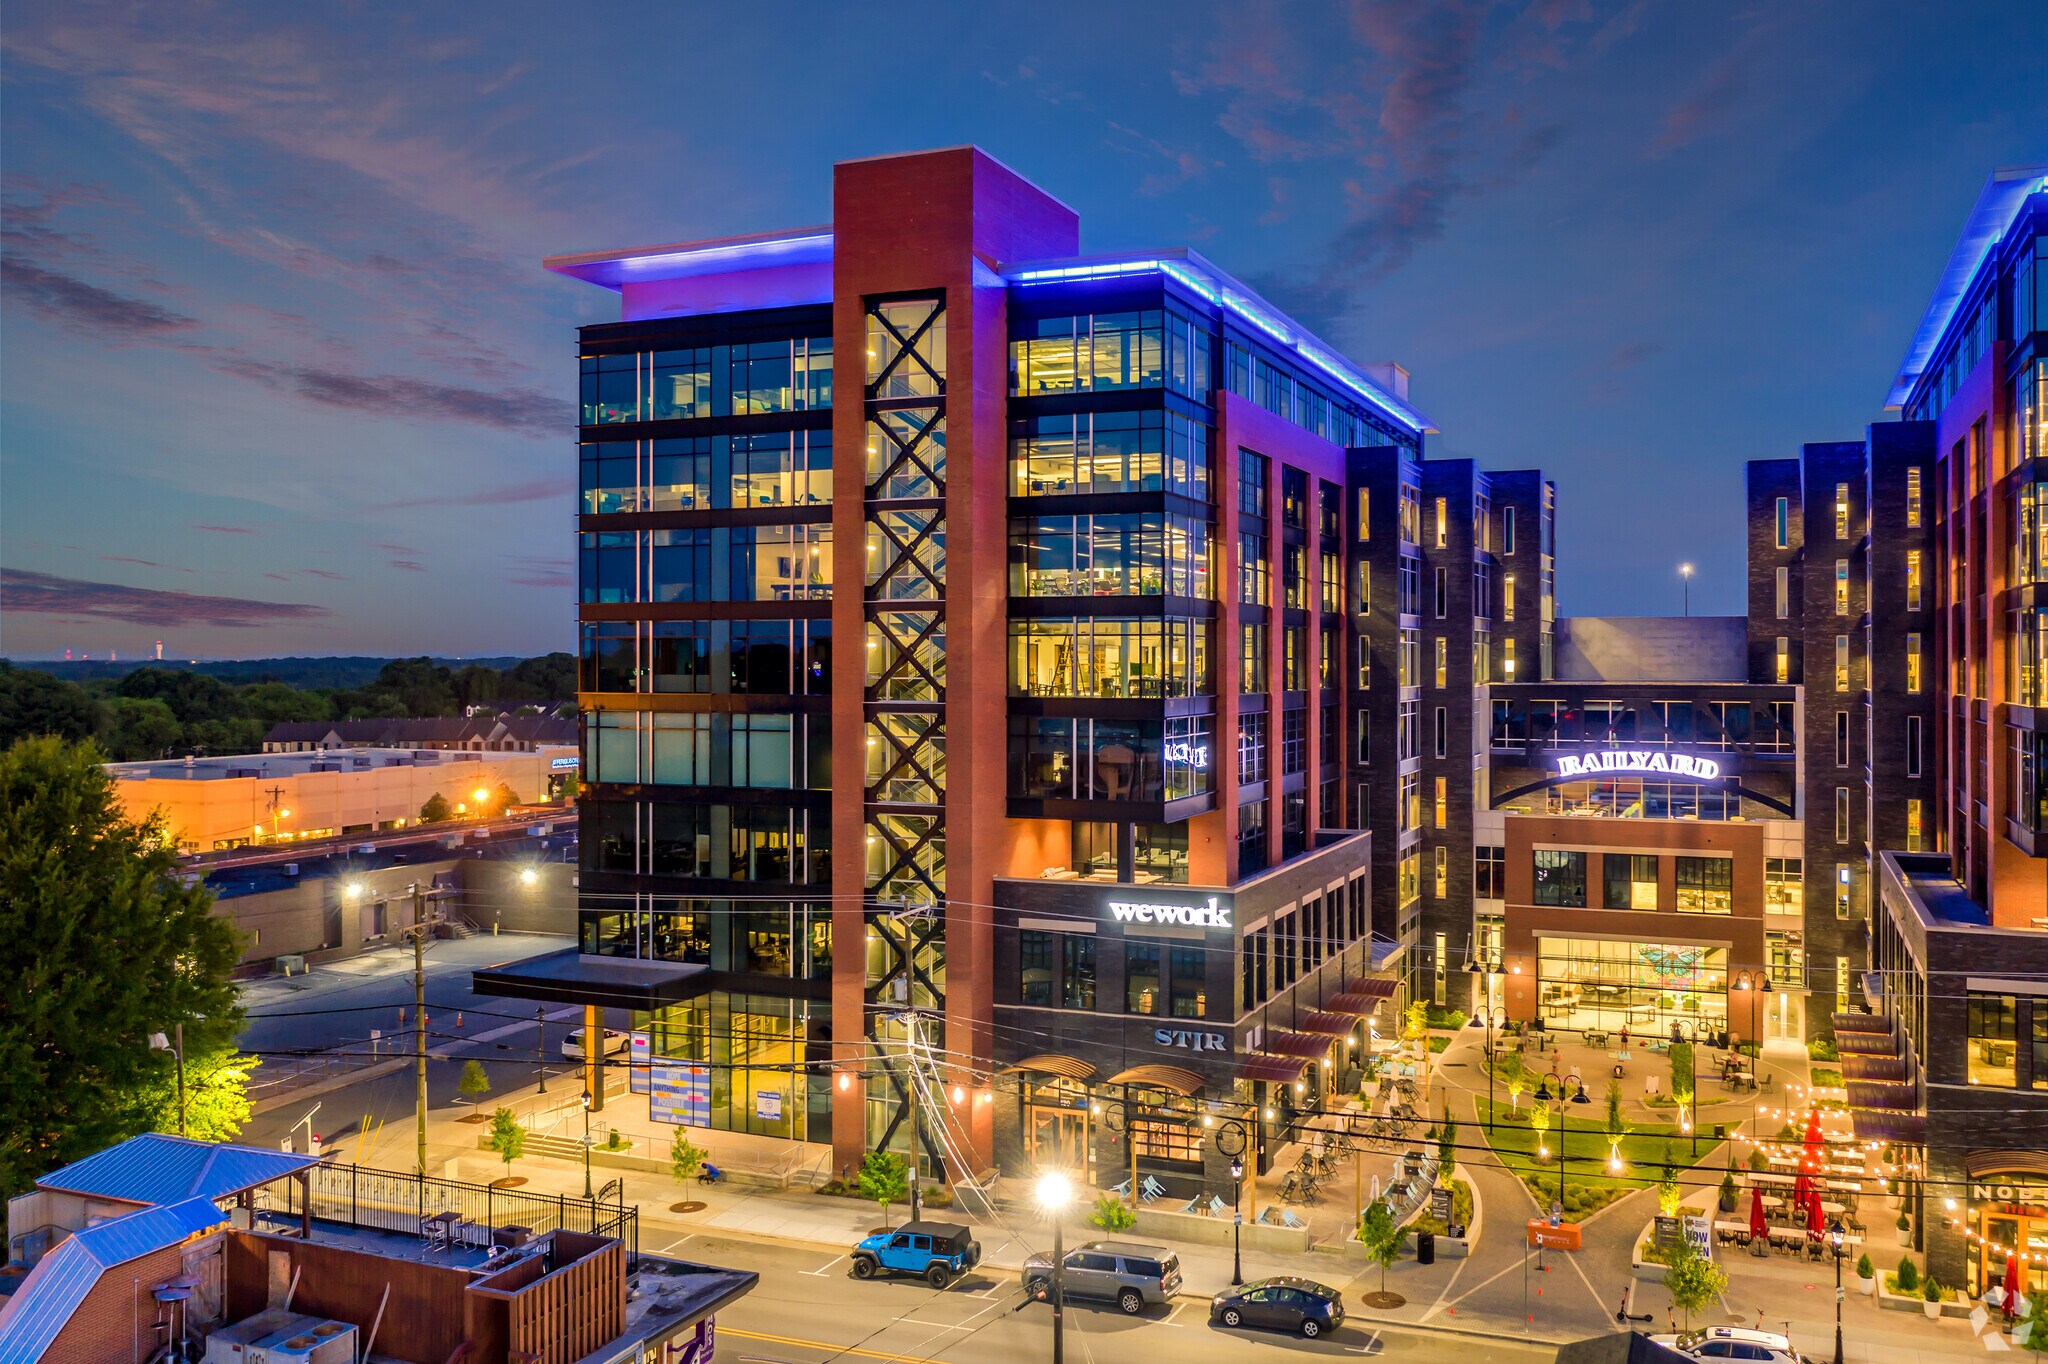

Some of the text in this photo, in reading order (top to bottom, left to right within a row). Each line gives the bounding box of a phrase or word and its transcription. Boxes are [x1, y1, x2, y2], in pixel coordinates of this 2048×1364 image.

[1556, 751, 1719, 780] RAILYARD
[1108, 897, 1233, 928] wework
[1154, 1028, 1227, 1052] STIR
[665, 1071, 681, 1081] HOPE
[653, 1083, 680, 1094] ANYTHING
[658, 1097, 685, 1109] POSSIBLE
